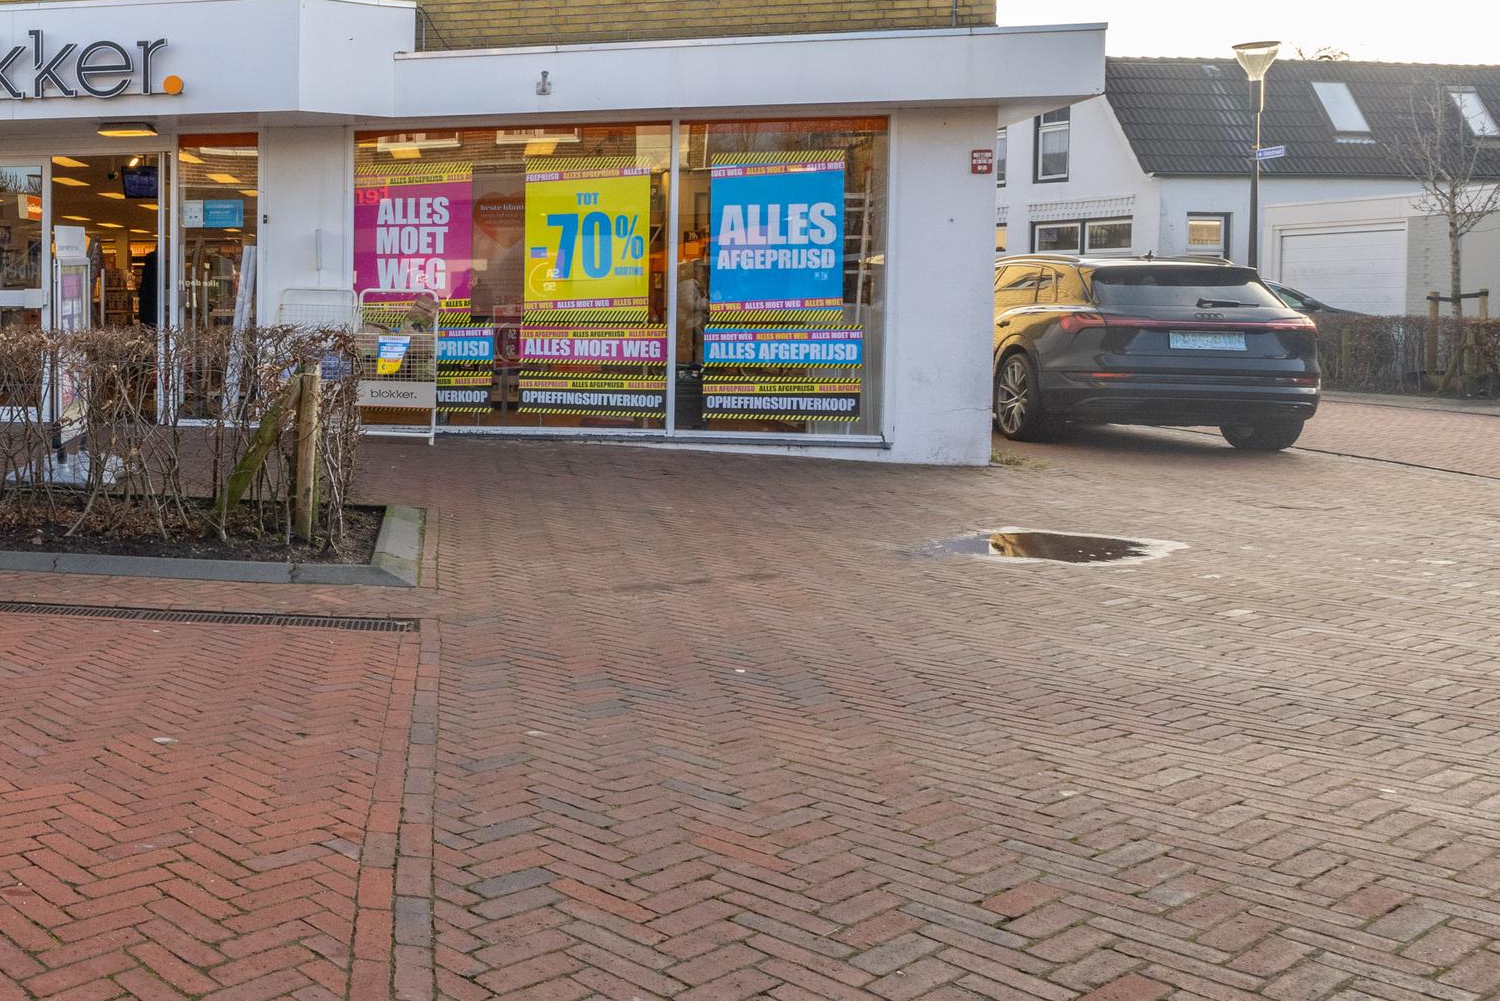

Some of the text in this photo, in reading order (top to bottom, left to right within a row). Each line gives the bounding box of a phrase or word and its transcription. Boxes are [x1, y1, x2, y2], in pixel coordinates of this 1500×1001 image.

[576, 192, 599, 205] TOT
[377, 196, 450, 225] ALLES
[718, 202, 837, 246] ALLES
[376, 226, 449, 255] MOET
[717, 248, 836, 270] AFGEPRIJSD
[377, 257, 446, 291] WEG
[765, 301, 784, 309] MOET
[785, 300, 801, 308] WEG
[437, 340, 489, 357] PRIJSD
[524, 339, 661, 358] ALLES MOET WEG
[709, 343, 857, 360] ALLES AFGEPRIJSD
[522, 391, 662, 408] OPHEFFINGSUITVERKOOP
[707, 396, 855, 411] OPHEFFINGSUITVERKOOP
